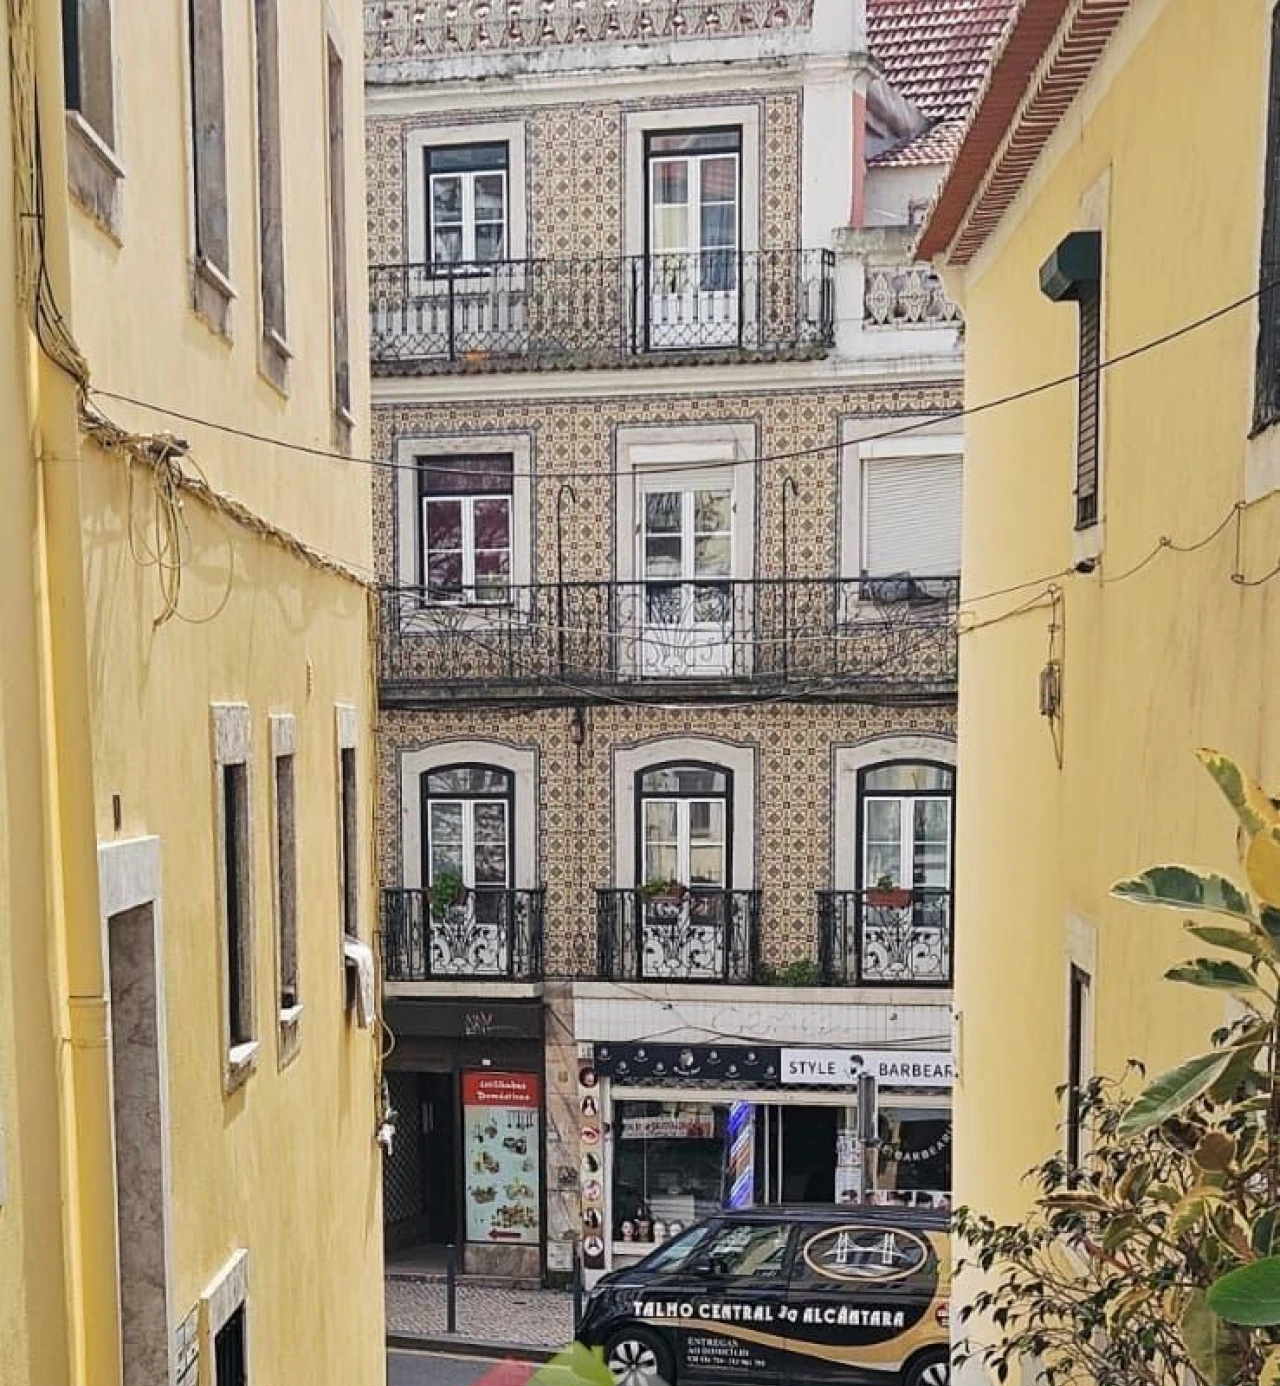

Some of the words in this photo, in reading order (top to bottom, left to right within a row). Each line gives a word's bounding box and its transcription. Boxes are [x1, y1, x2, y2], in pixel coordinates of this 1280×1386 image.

[789, 1061, 836, 1075] STYLE
[633, 1301, 694, 1317] TALHO
[699, 1303, 773, 1321] CENTRAL
[803, 1304, 904, 1327] ALCÂNTARA
